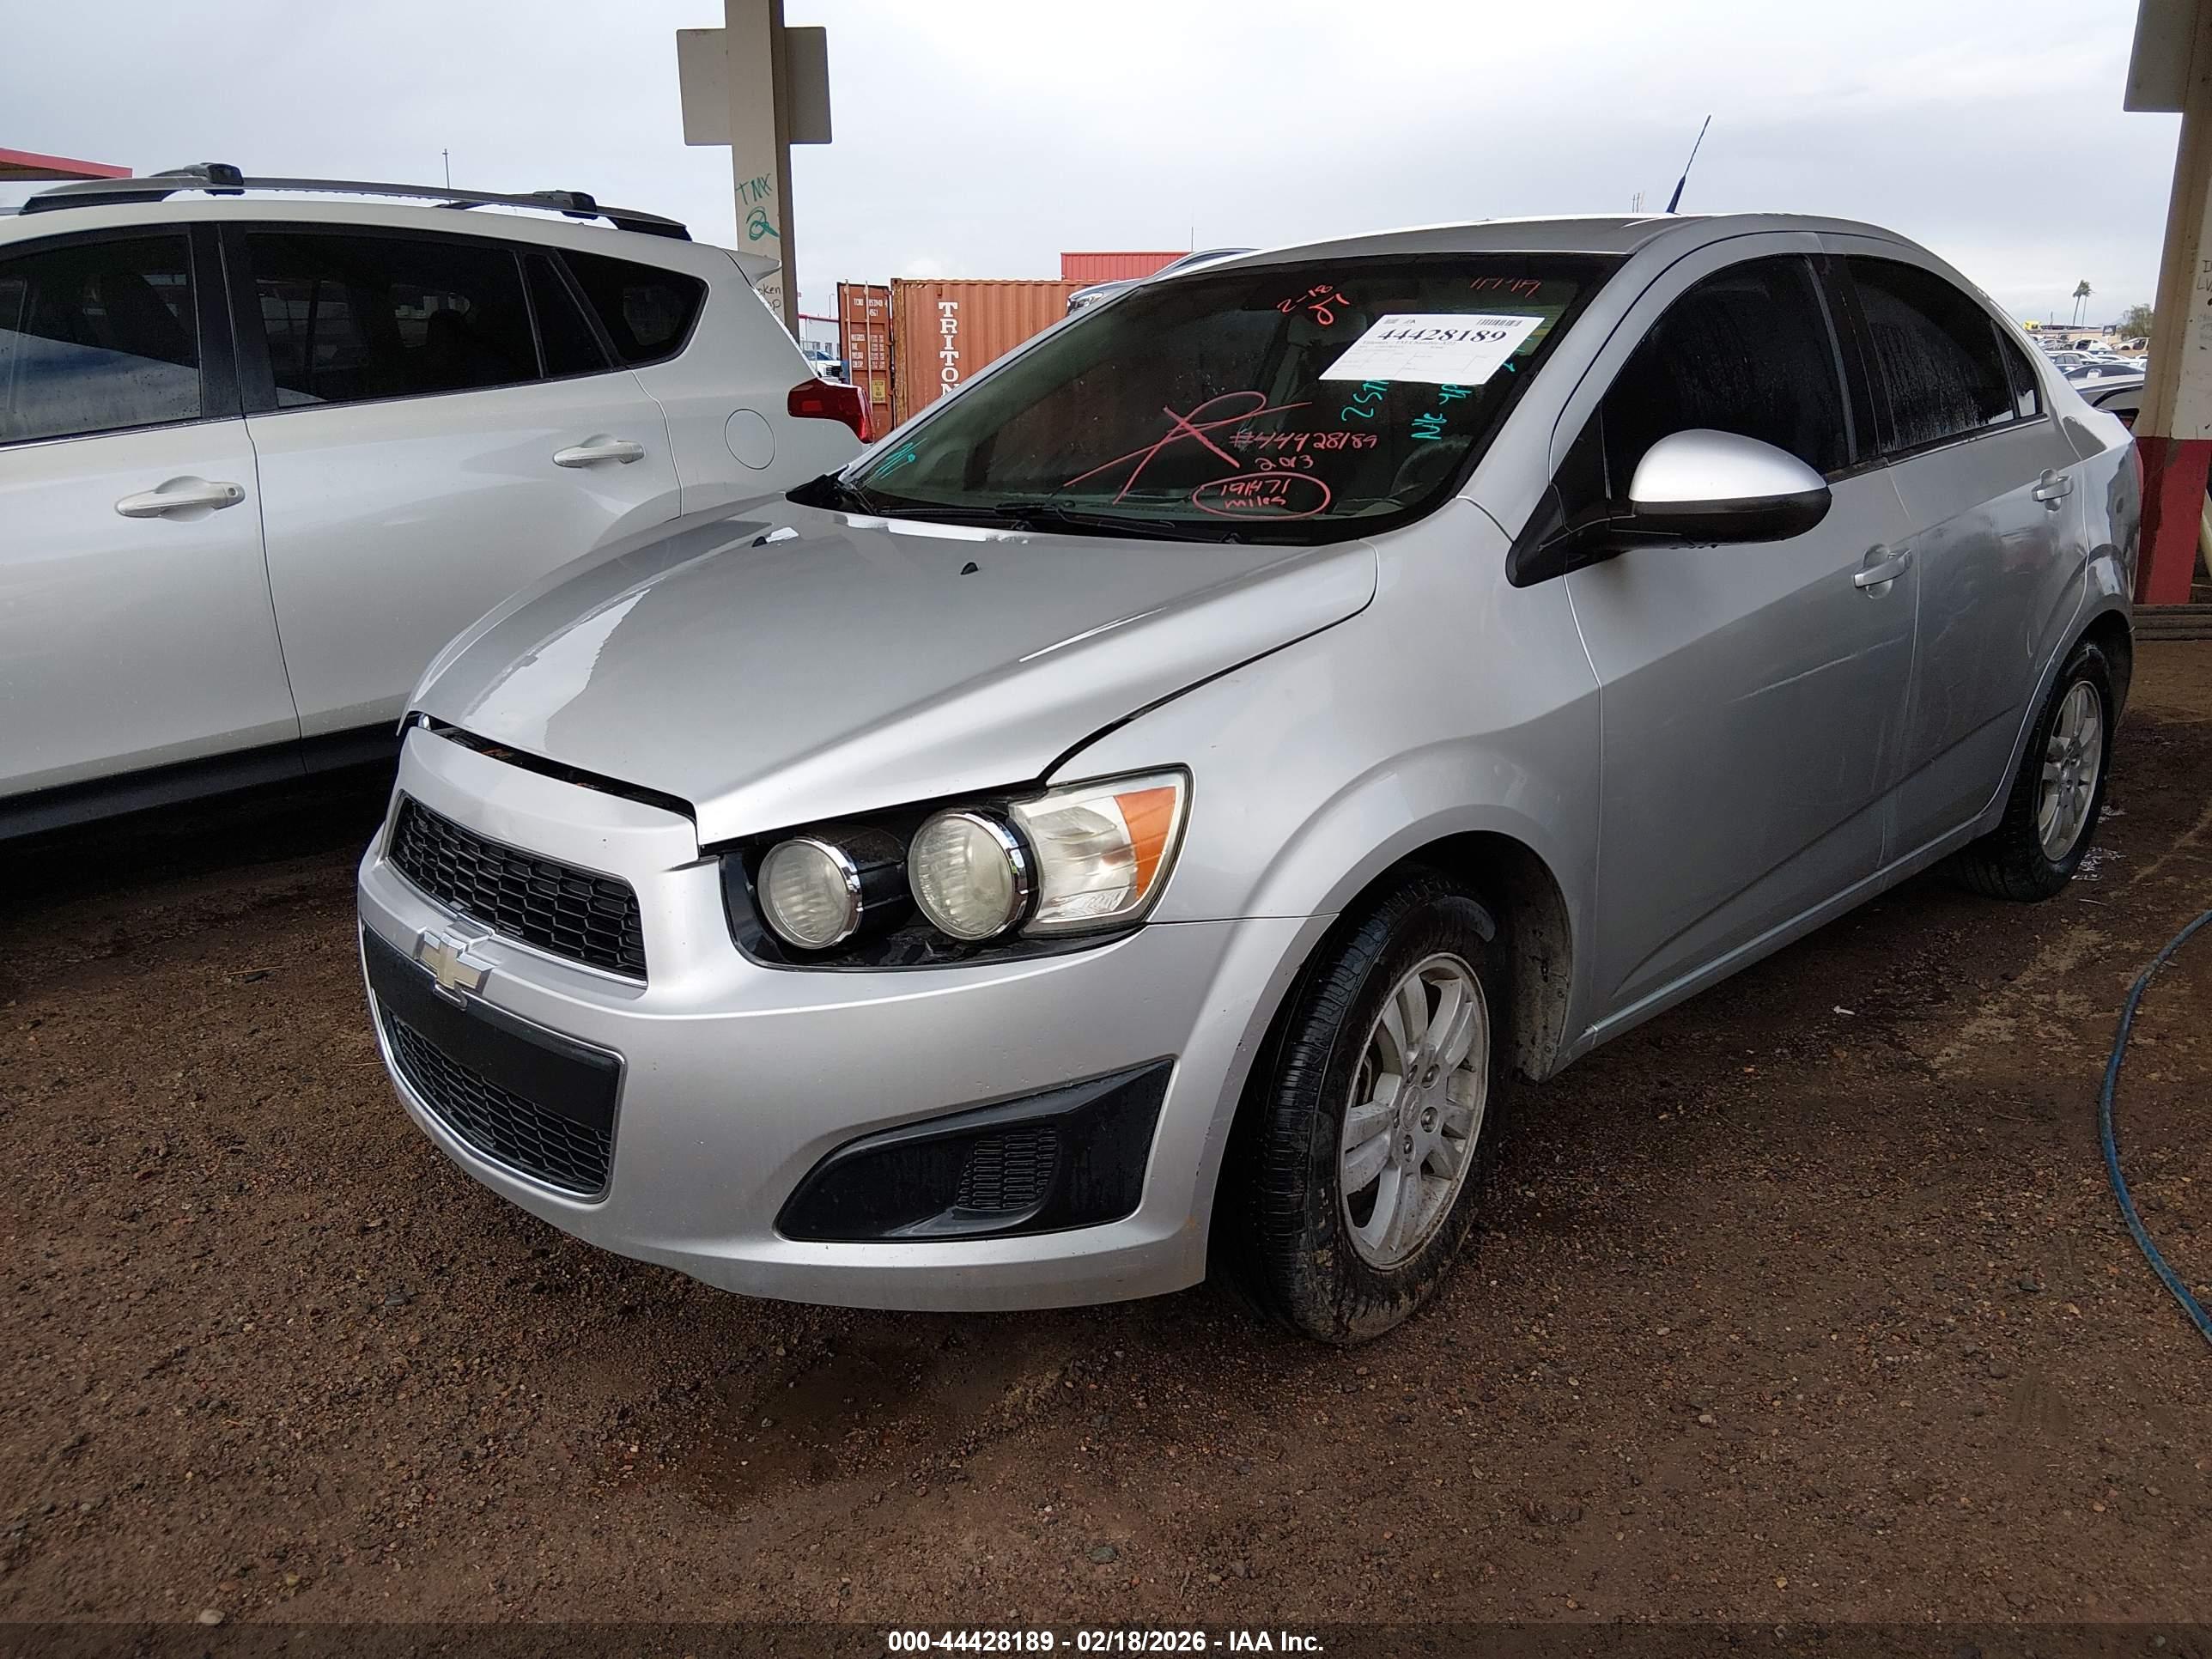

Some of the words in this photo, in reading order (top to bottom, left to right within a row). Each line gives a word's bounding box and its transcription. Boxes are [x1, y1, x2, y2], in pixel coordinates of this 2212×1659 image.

[757, 284, 781, 296] oken
[1377, 328, 1508, 343] 44428189
[1255, 454, 1314, 471] 2013
[1224, 495, 1286, 509] miles
